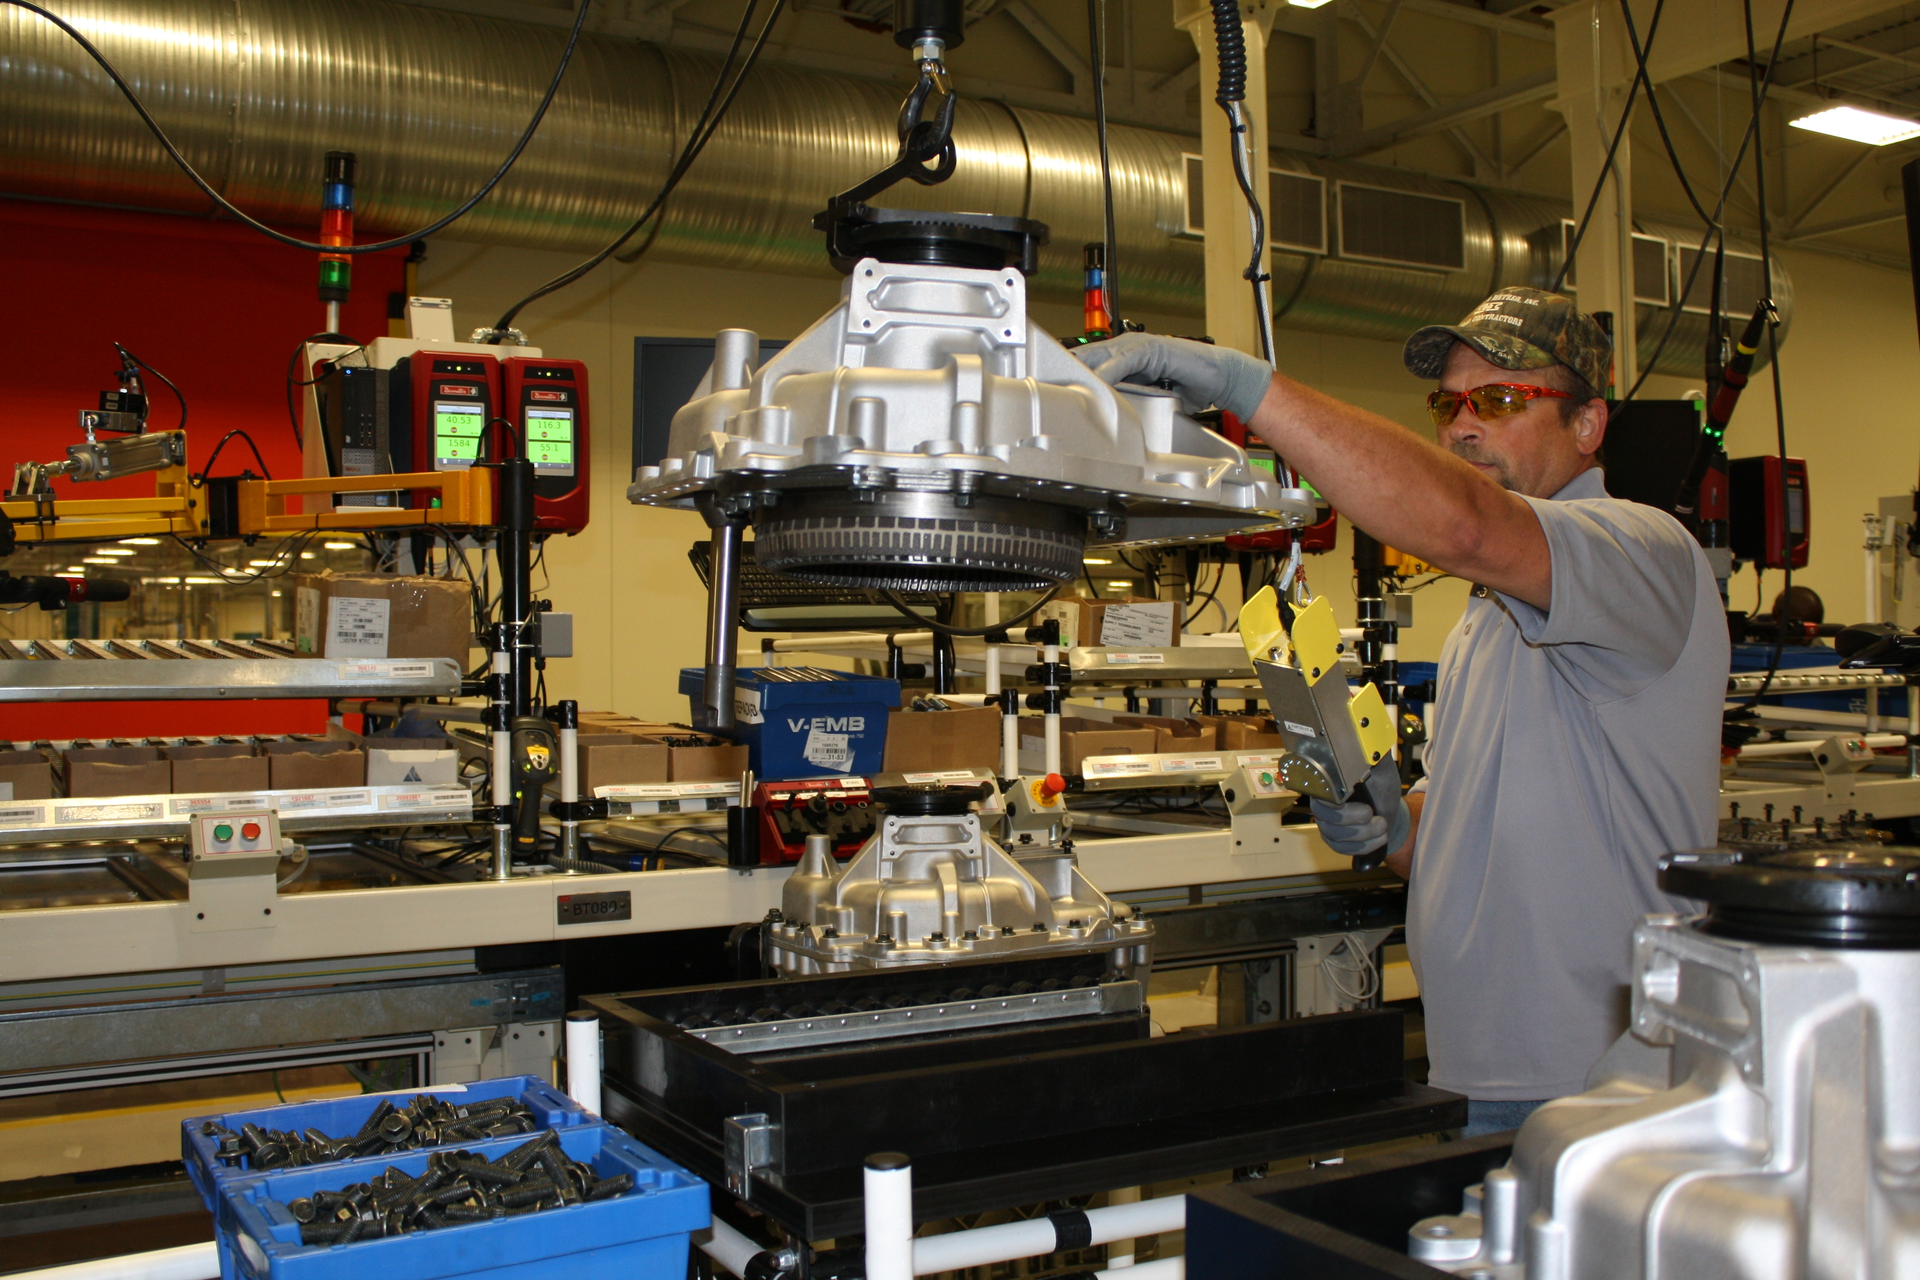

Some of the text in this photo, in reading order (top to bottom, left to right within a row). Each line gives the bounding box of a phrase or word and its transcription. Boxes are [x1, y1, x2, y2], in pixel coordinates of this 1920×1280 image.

[1472, 313, 1524, 327] CONTRACTORS
[446, 416, 471, 425] 40.53
[537, 421, 561, 430] 116.3
[448, 439, 470, 447] 1584
[540, 444, 559, 452] 55.1
[787, 716, 865, 733] V-EMB
[573, 901, 617, 916] BT080
